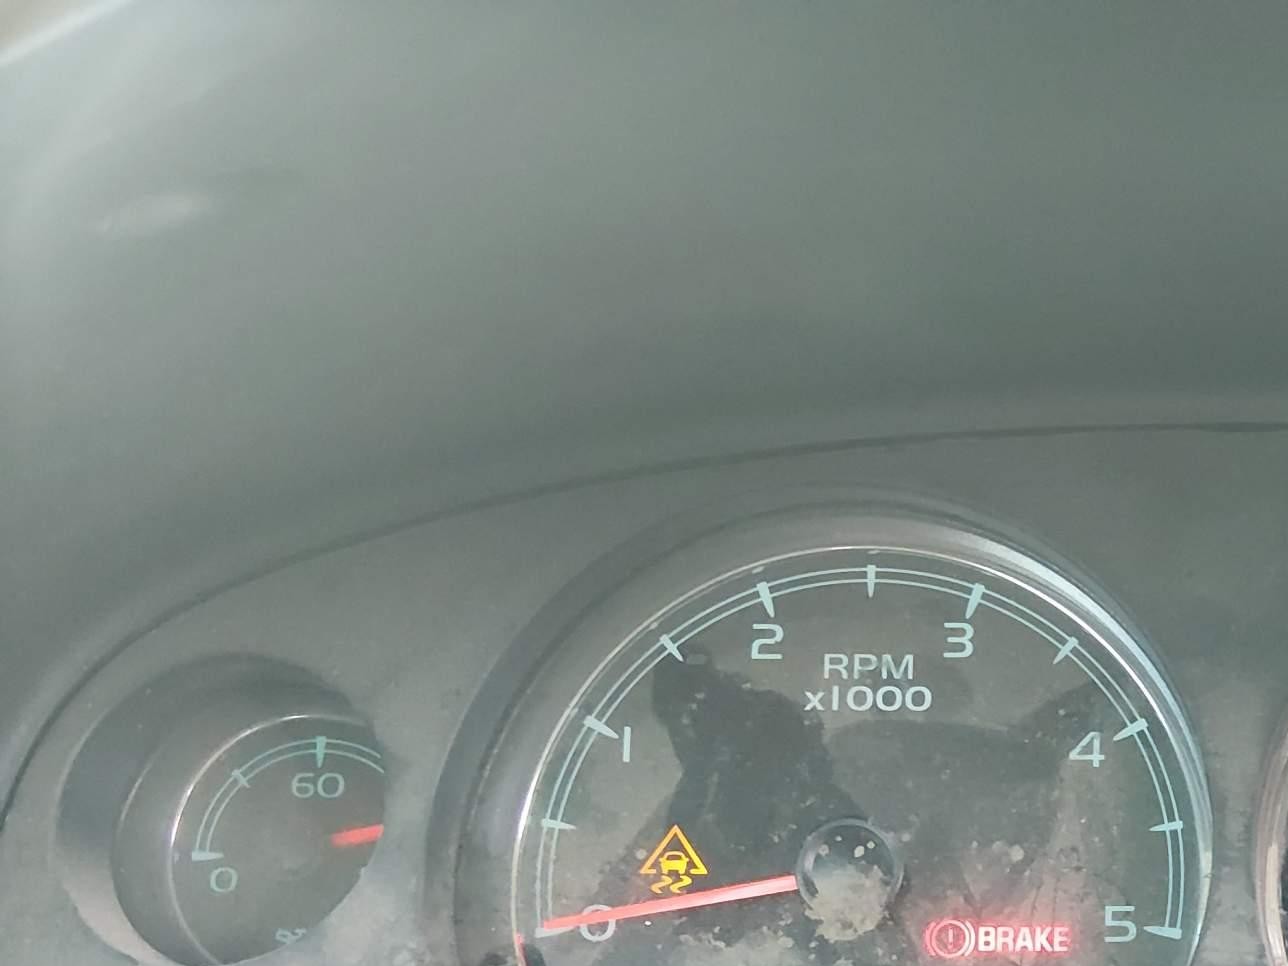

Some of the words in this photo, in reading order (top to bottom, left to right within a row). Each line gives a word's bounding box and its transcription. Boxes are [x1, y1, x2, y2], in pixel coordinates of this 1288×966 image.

[750, 624, 784, 660] 2
[942, 622, 975, 659] 3
[822, 653, 915, 681] RPM
[803, 686, 933, 712] x1000
[621, 726, 632, 763] 1
[1068, 730, 1105, 766] 4
[290, 772, 346, 799] 60
[209, 867, 238, 893] 0
[978, 927, 1069, 953] BRAKE
[1104, 905, 1136, 944] 5
